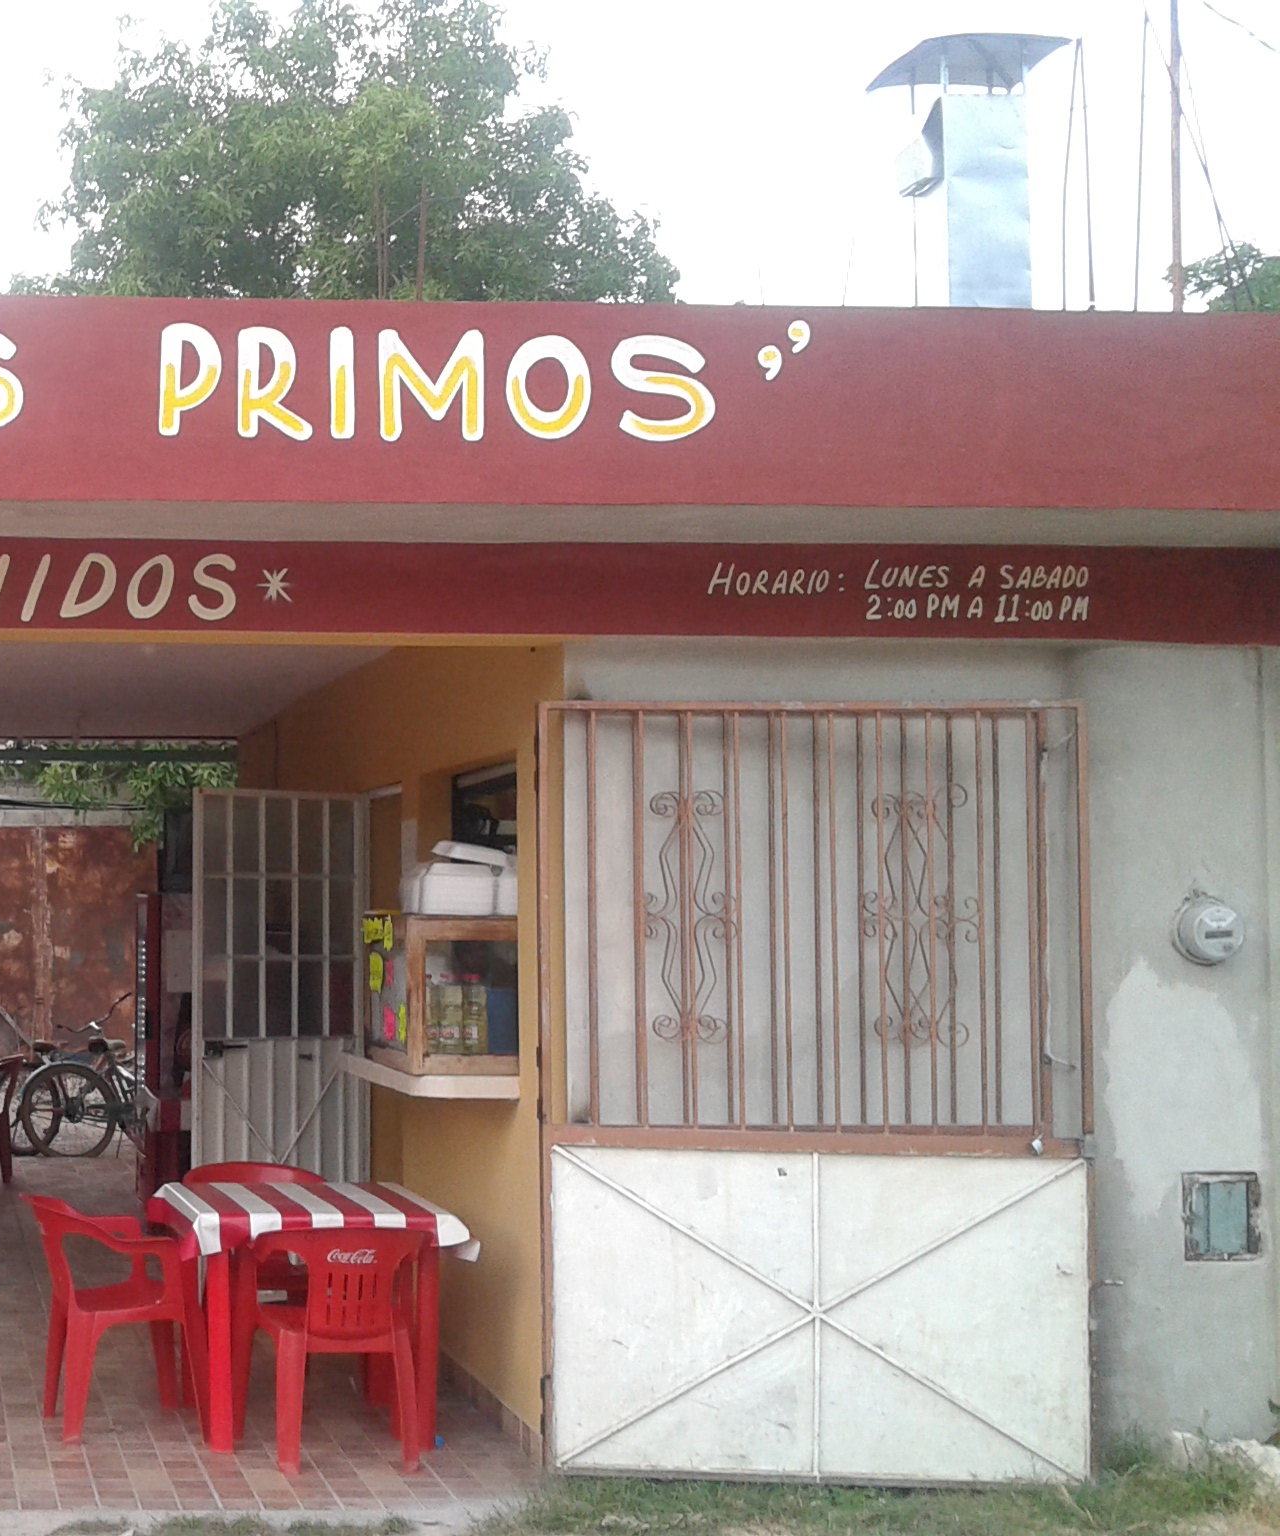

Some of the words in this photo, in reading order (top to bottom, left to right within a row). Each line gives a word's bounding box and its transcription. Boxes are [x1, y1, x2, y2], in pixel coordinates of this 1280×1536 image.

[707, 561, 846, 596] HORARIO:
[864, 558, 950, 590] LUNES
[967, 565, 986, 588] A
[999, 565, 1089, 589] SABADO
[865, 595, 917, 621] 2:00
[926, 594, 960, 619] PM
[966, 597, 983, 619] A
[994, 595, 1053, 624] 11:00
[1058, 596, 1089, 621] PM
